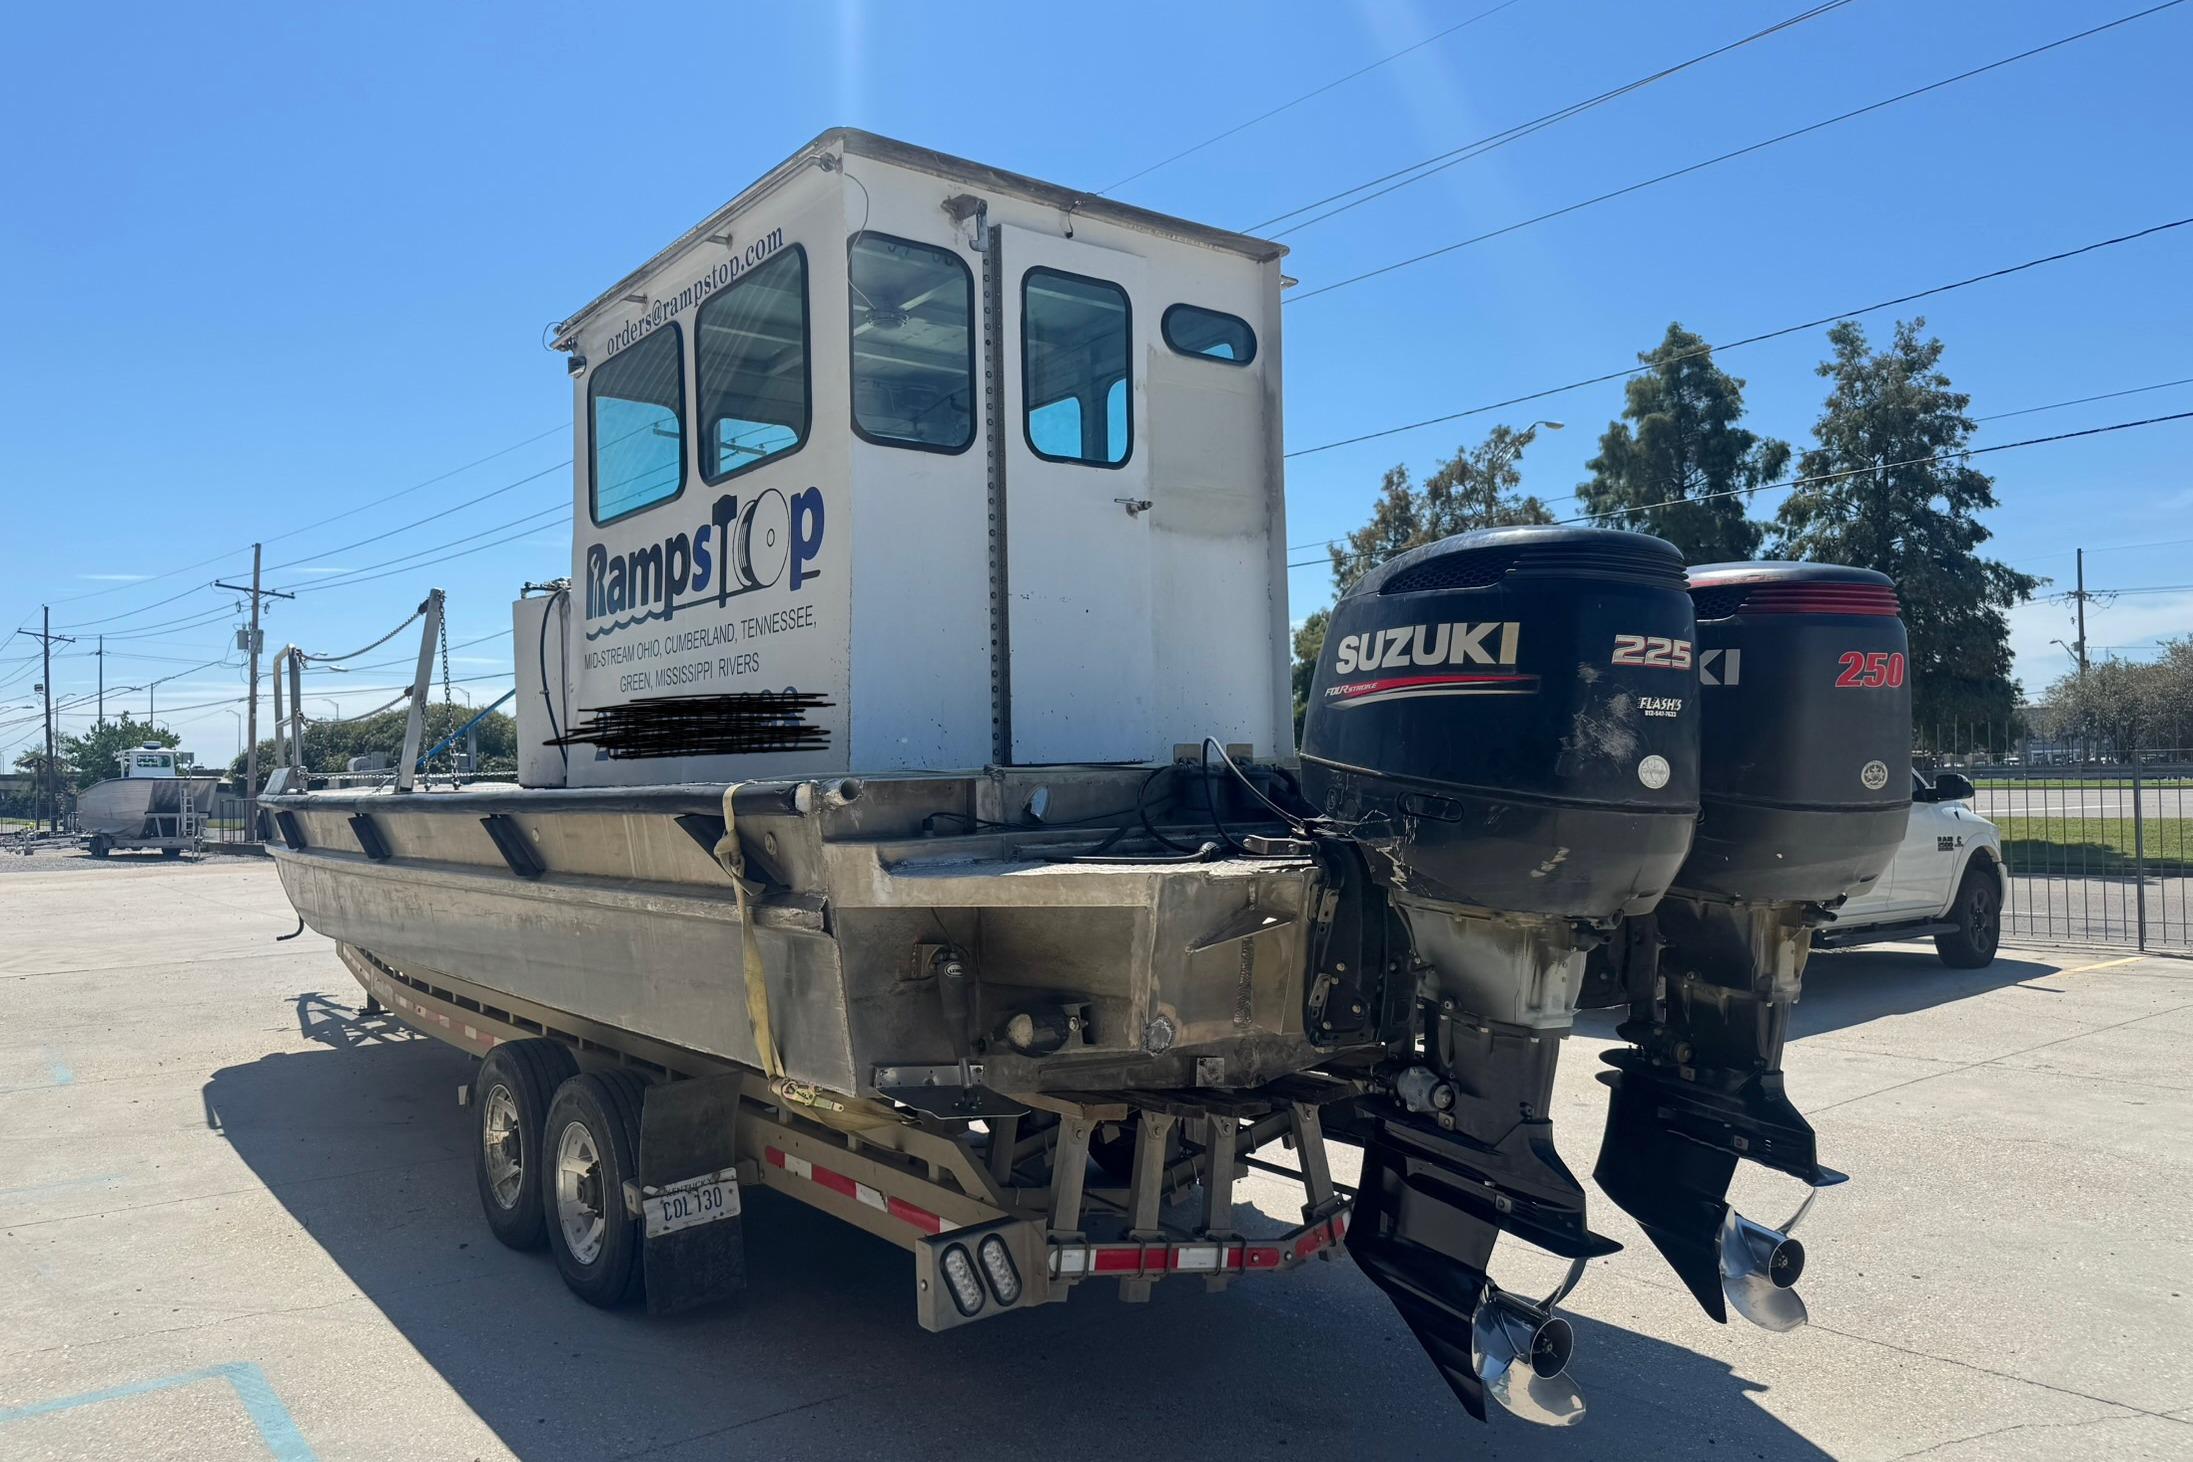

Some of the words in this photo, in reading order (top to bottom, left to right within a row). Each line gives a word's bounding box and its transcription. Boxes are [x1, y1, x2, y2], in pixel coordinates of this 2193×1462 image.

[606, 226, 784, 356] orders@rampstop.com
[584, 644, 635, 671] MID-STREAM
[636, 639, 662, 661] OHIO,
[664, 623, 738, 656] CUMBERLAND,
[740, 604, 817, 639] TENNESSEE,
[1335, 622, 1521, 675] SUZUKI
[1611, 634, 1692, 670] 225
[619, 670, 653, 693] GREEN,
[655, 660, 713, 688] MISSISSIPPI
[718, 652, 760, 679] RIVERS
[1835, 651, 1905, 688] 250
[694, 1186, 723, 1213] 130
